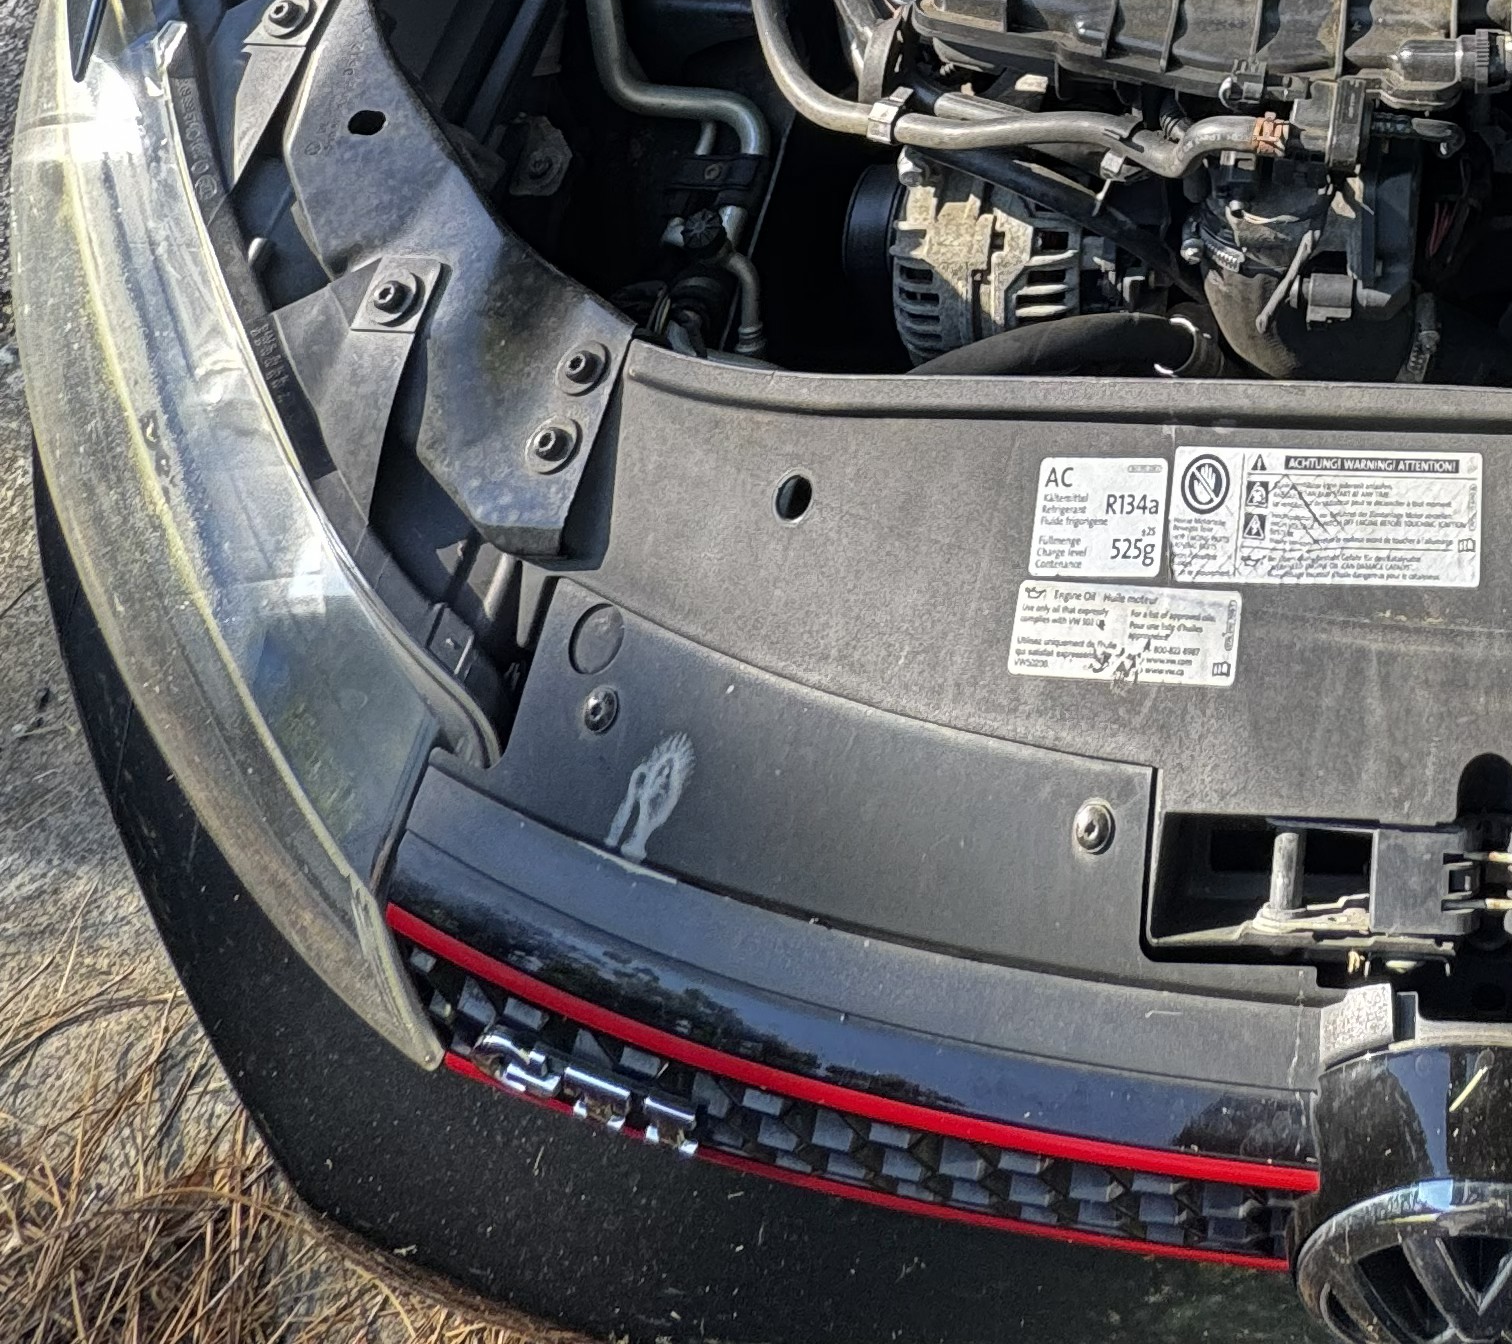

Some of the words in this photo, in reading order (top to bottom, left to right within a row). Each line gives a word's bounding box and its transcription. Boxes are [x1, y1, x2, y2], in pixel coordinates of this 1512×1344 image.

[1288, 457, 1341, 470] ACHTUNG!
[1344, 459, 1395, 471] WARNING!
[1398, 461, 1457, 472] ATTENTION!
[1045, 467, 1074, 487] AC
[1105, 494, 1160, 515] R134a
[1110, 538, 1155, 567] 525g
[1053, 590, 1082, 602] Engine
[1083, 592, 1096, 601] Oil
[1103, 593, 1125, 603] Huile
